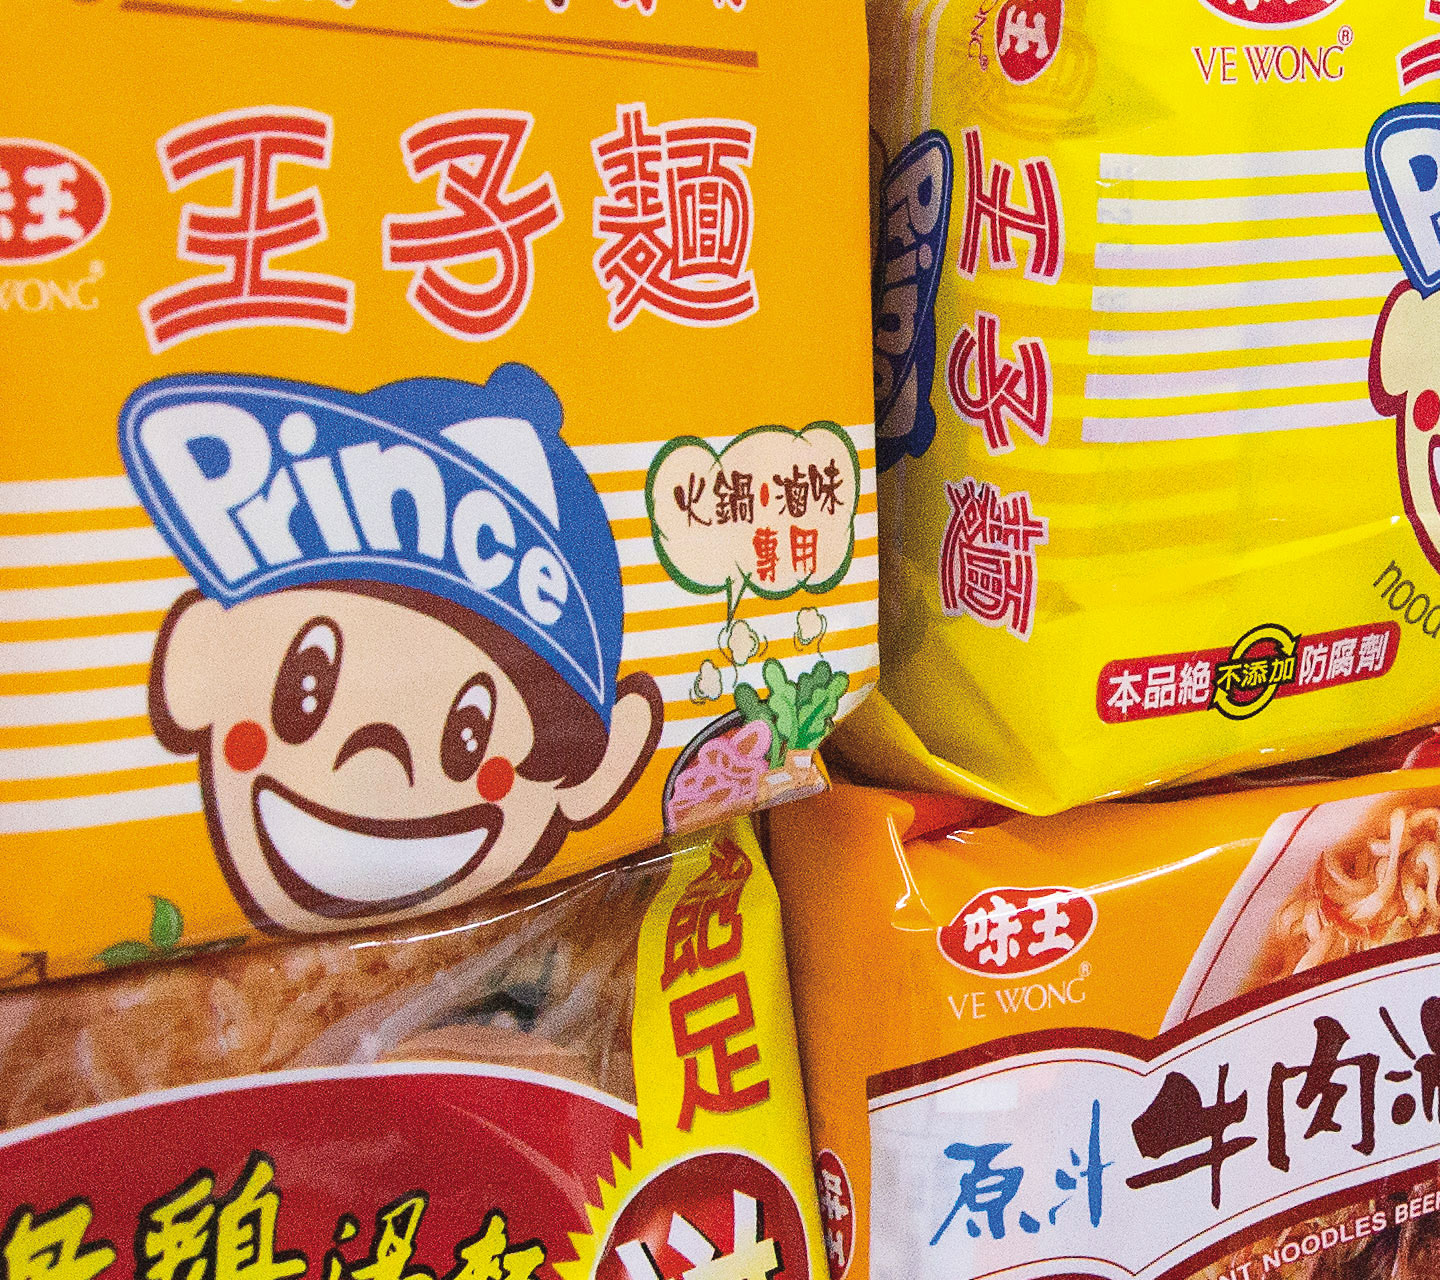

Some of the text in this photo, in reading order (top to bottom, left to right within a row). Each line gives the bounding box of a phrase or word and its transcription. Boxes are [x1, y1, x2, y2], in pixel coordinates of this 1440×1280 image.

[1194, 45, 1346, 86] VE WONG
[139, 102, 760, 355] 王子麵
[941, 125, 1065, 642] 王子麵
[140, 402, 568, 625] Prince
[962, 898, 1081, 959] 味王
[948, 974, 1087, 1022] VE WONG
[1262, 1210, 1388, 1272] NOODLES
